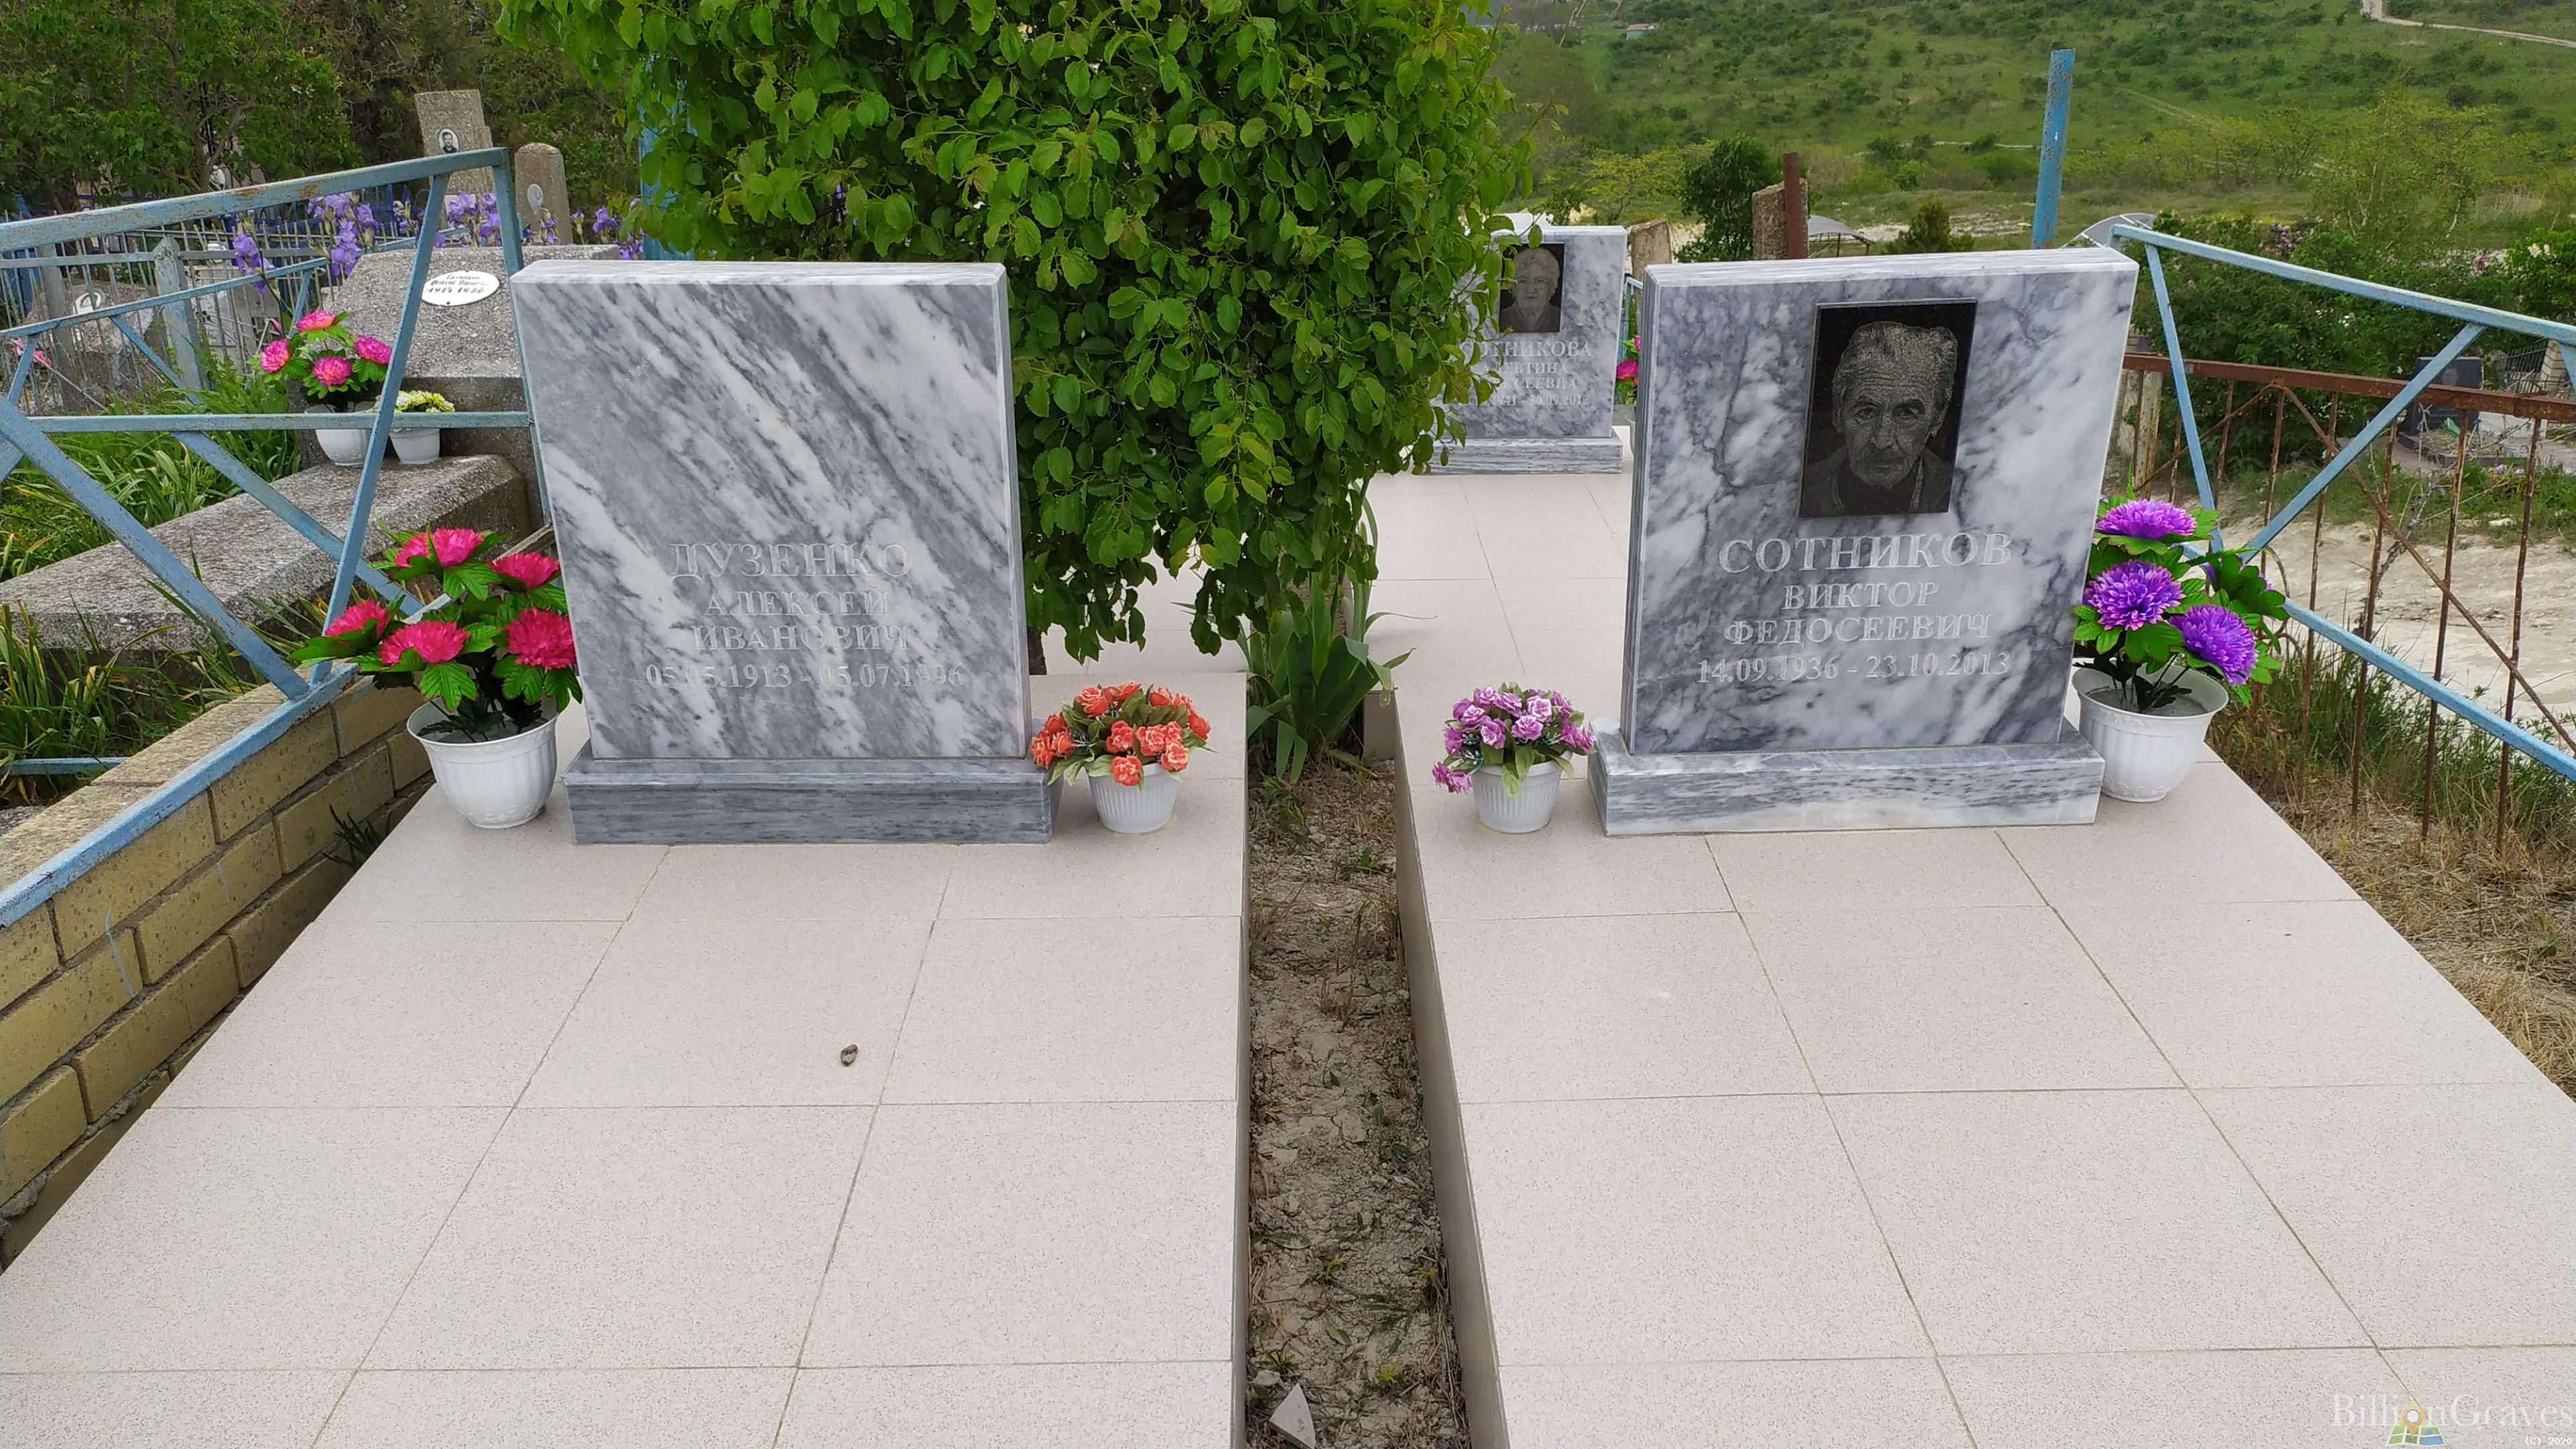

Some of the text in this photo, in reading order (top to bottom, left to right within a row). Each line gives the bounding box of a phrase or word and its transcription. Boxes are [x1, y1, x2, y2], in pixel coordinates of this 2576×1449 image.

[668, 541, 914, 584] ДУЗЕНКО
[1717, 532, 2013, 574] СОТНИКОВ
[703, 587, 893, 616] АЛЕКСЕЙ
[1781, 581, 1940, 610] ВИКТОР
[690, 624, 911, 651] ИВАНОВИЧ
[1724, 613, 1994, 649] ФЕДОСЕЕВИЧ
[645, 664, 794, 690] 05.05.1913
[820, 662, 966, 689] 05.07.1996
[1696, 654, 1840, 684] 14.09.1936
[1865, 651, 2011, 679] 23.10.2013
